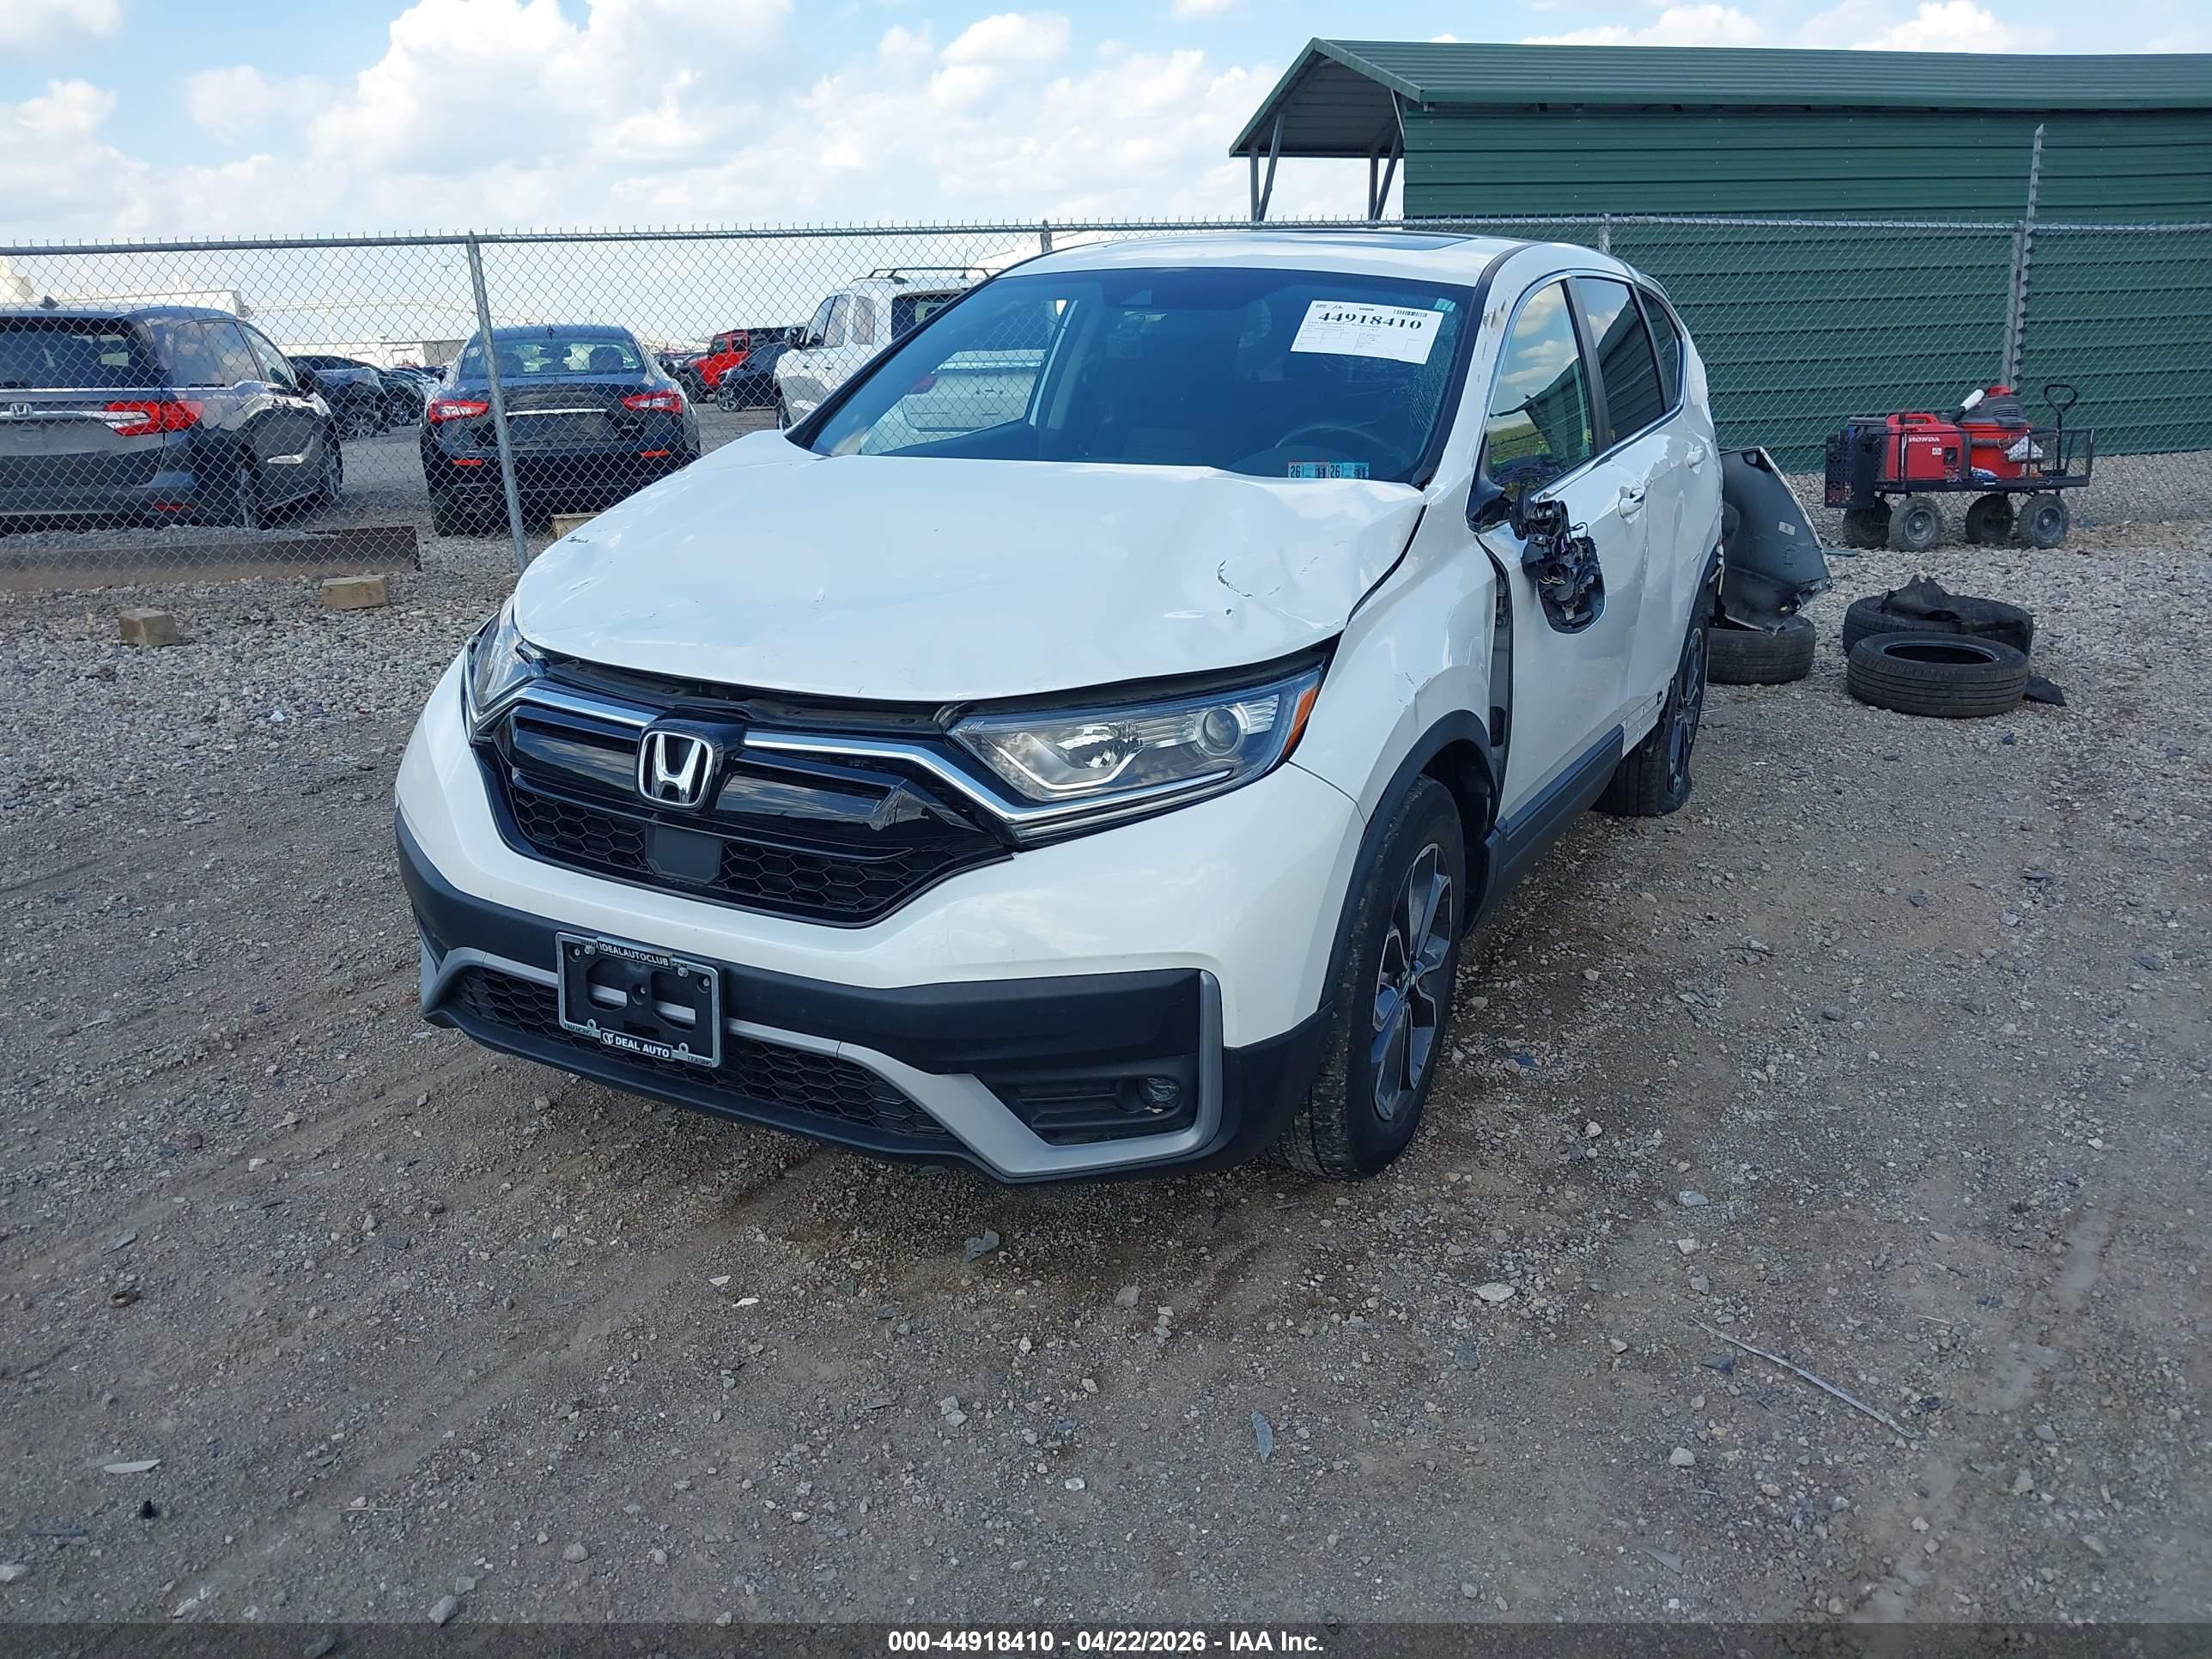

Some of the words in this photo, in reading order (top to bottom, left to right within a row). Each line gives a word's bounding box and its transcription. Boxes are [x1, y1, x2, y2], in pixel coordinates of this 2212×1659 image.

[1318, 313, 1422, 330] 44918410
[1291, 465, 1301, 478] 26
[1330, 465, 1340, 478] 26
[599, 941, 669, 966] IDEALAUTOCLUB
[642, 1044, 670, 1058] AUTO
